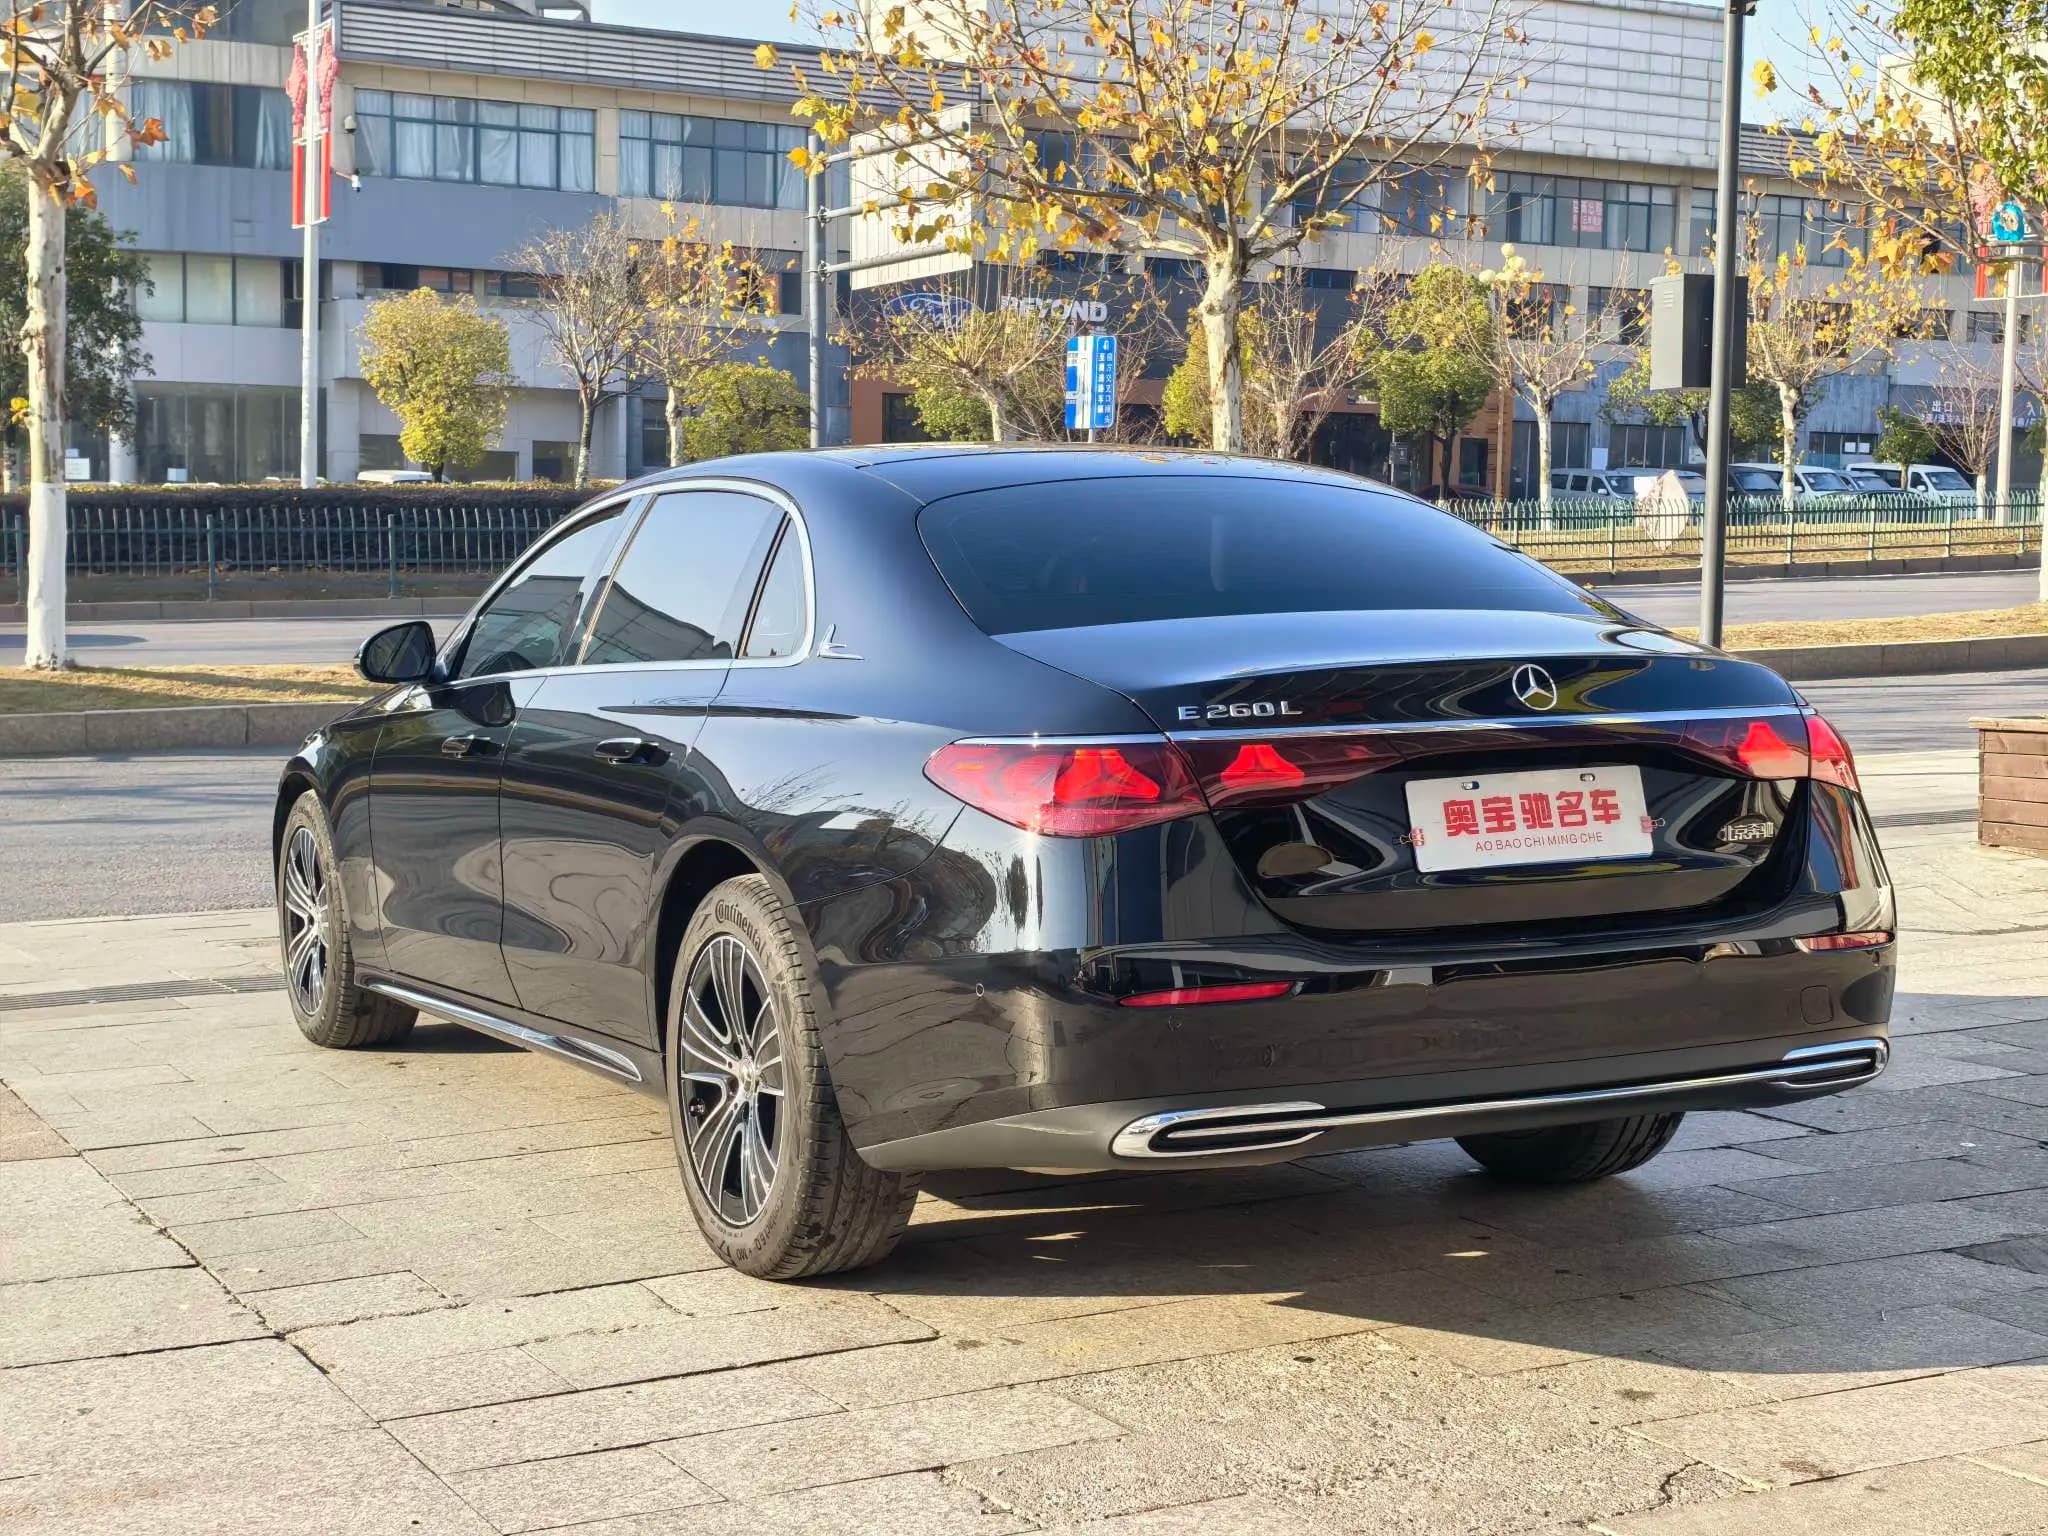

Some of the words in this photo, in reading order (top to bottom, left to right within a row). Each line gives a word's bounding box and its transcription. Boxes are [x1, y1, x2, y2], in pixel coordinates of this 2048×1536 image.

[1178, 705, 1201, 720] E
[1206, 702, 1275, 719] 260
[1280, 700, 1303, 715] L
[1442, 788, 1621, 837] 奥宝驰名车
[1475, 841, 1493, 853] AO
[1496, 838, 1522, 850] BAO
[1524, 836, 1546, 848] CHI
[1547, 832, 1578, 846] MING
[1580, 831, 1604, 844] CHE
[714, 899, 767, 958] Continental
